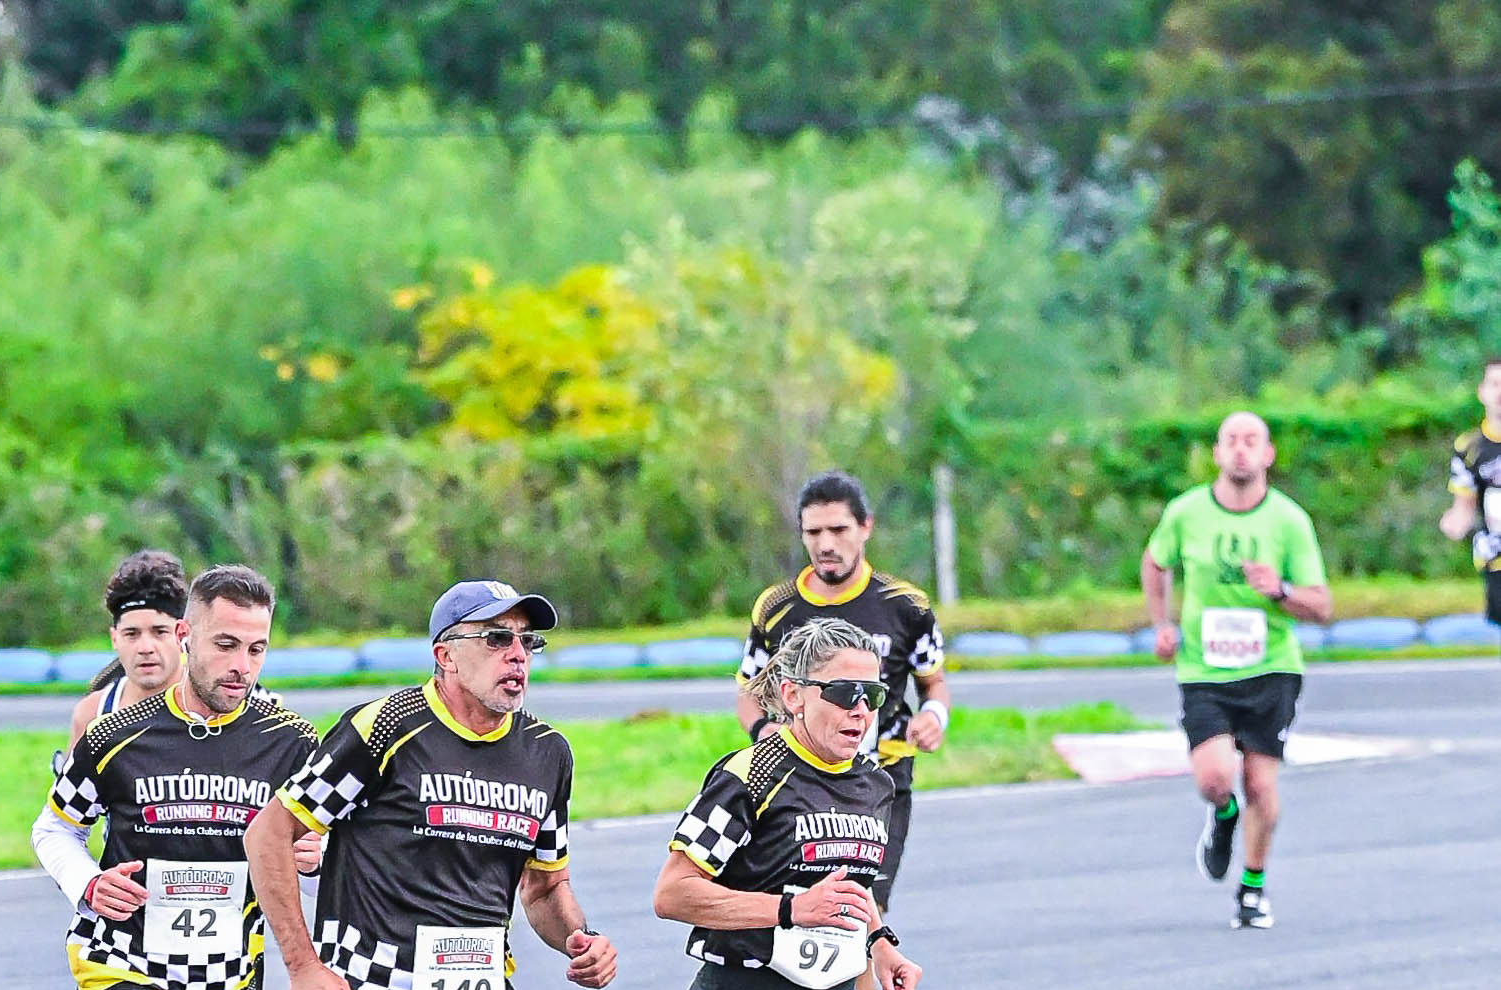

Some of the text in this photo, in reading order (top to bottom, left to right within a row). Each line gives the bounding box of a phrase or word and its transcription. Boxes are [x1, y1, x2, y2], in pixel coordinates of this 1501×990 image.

[135, 767, 271, 808] AUTÓDROMO
[419, 770, 548, 820] AUTÓDROMO
[155, 804, 250, 824] RUNNING RACE
[442, 807, 532, 835] RUNNING RACE
[134, 824, 144, 833] La
[144, 825, 171, 834] Carrera
[172, 826, 183, 835] de
[183, 826, 196, 836] los
[196, 826, 223, 837] Clubes
[223, 828, 237, 837] del
[412, 825, 424, 834] La
[424, 826, 455, 839] Carrera
[455, 830, 466, 841] de
[466, 832, 478, 843] los
[478, 834, 503, 846] Clubes
[503, 838, 517, 848] del
[815, 842, 882, 864] RUNNING RACE
[161, 866, 235, 886] AUTÓDROMO
[171, 908, 218, 938] 42
[798, 939, 840, 973] 97
